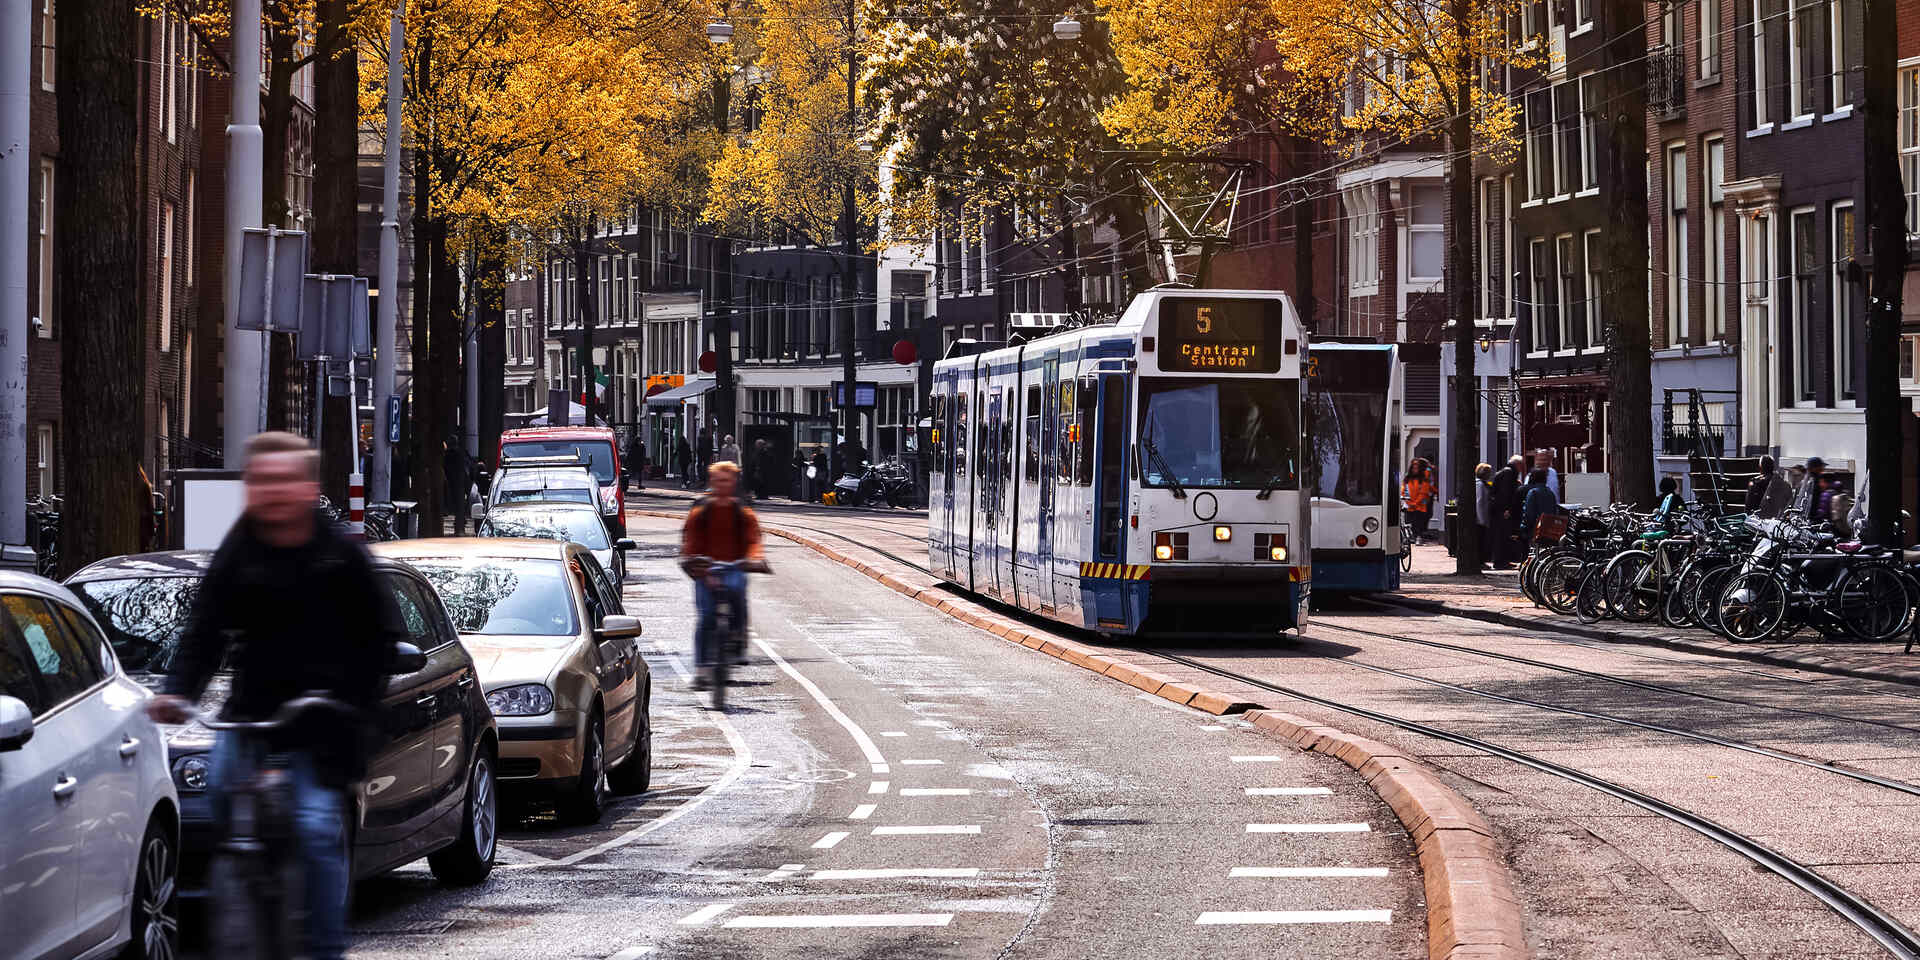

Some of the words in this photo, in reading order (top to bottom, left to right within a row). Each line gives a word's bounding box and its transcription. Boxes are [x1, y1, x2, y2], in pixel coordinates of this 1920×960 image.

[1196, 307, 1212, 334] 5
[1182, 344, 1256, 356] Centraal
[1191, 355, 1246, 366] Station
[393, 400, 399, 421] P
